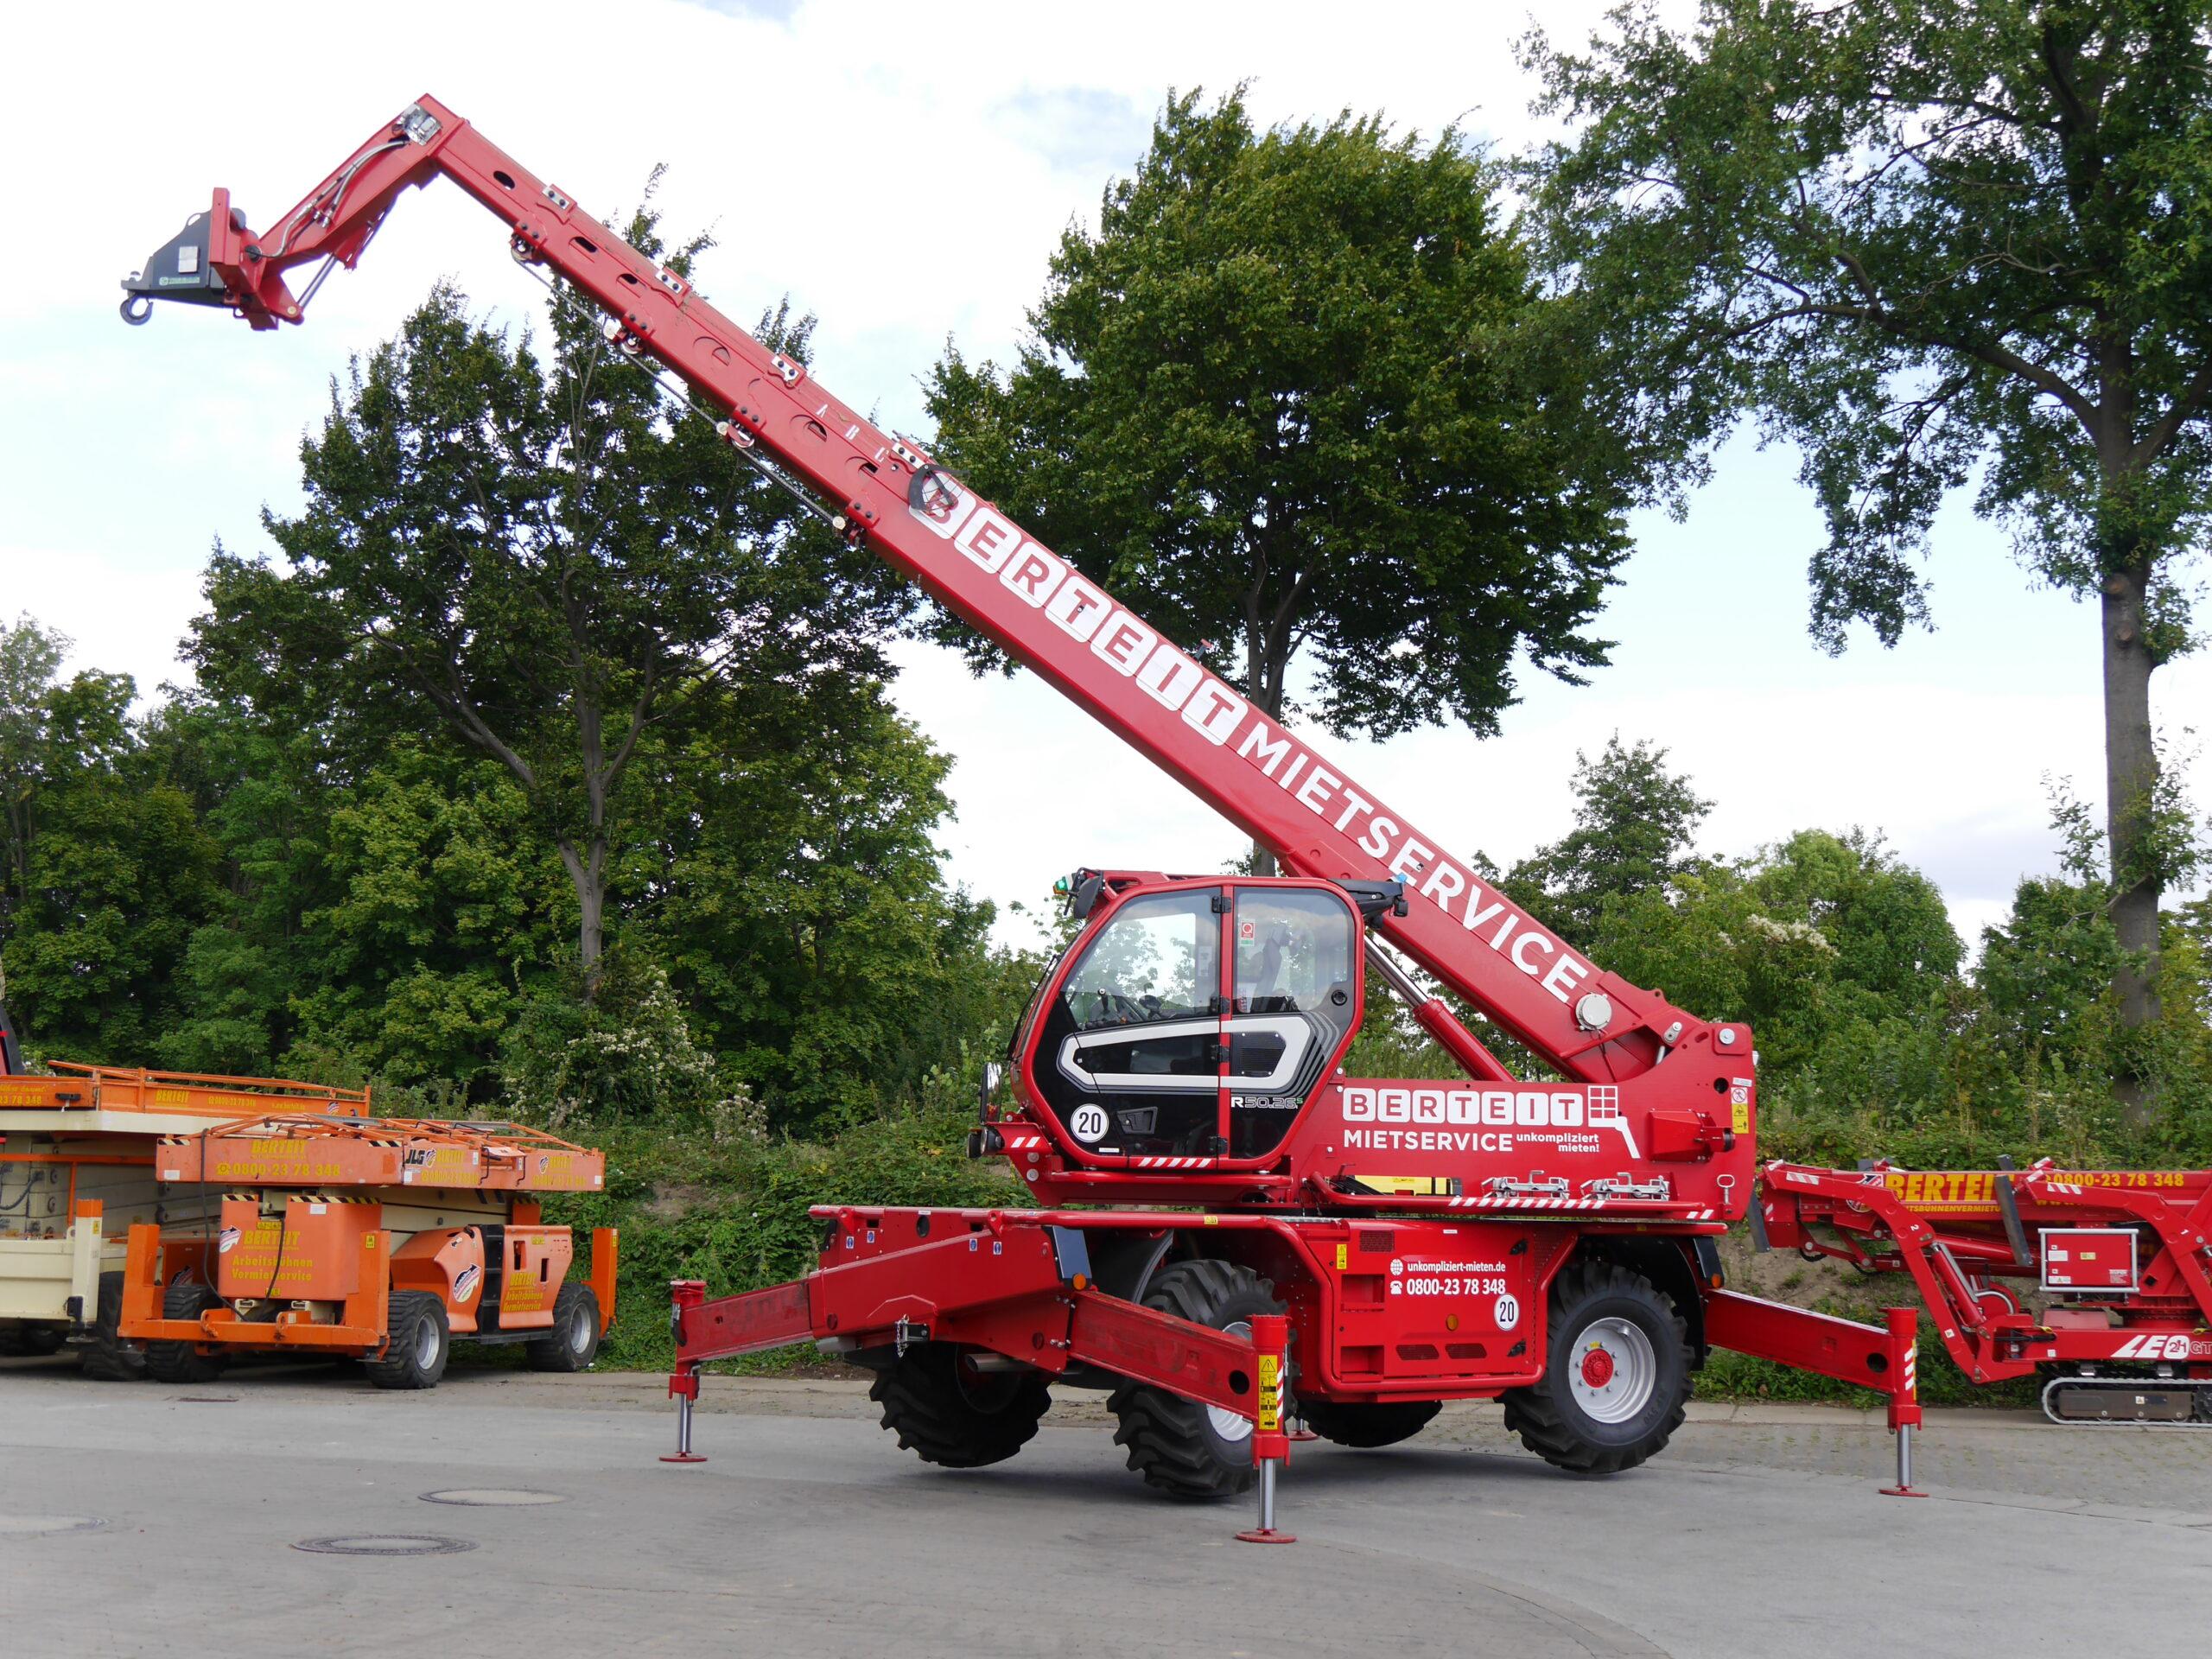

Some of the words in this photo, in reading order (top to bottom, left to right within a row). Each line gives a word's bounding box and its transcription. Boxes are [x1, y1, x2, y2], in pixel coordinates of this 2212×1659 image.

[918, 480, 1242, 737] BERTEIT
[1236, 721, 1589, 1003] MIETSERVICE
[1346, 1090, 1580, 1123] BERTEIT
[1078, 1111, 1102, 1135] 20
[251, 1140, 308, 1154] BERTEIT
[1344, 1129, 1513, 1152] MIETSERVICE
[1516, 1132, 1599, 1144] unkompliziert
[1558, 1141, 1600, 1153] mieten!
[404, 1149, 426, 1165] JLG
[293, 1163, 310, 1176] 78
[315, 1163, 340, 1176] 348
[1885, 1173, 2015, 1202] BERTEI
[2053, 1173, 2120, 1186] 0800-23
[2127, 1173, 2148, 1187] 78
[2153, 1173, 2185, 1187] 348
[244, 1230, 301, 1245] BERTIT
[1407, 1261, 1506, 1274] unkompliziert-mieten.de
[1406, 1278, 1460, 1295] 0800-23
[1463, 1278, 1479, 1295] 78
[1482, 1278, 1506, 1295] 348
[1499, 1300, 1515, 1323] 20
[2110, 1334, 2190, 1360] LEO
